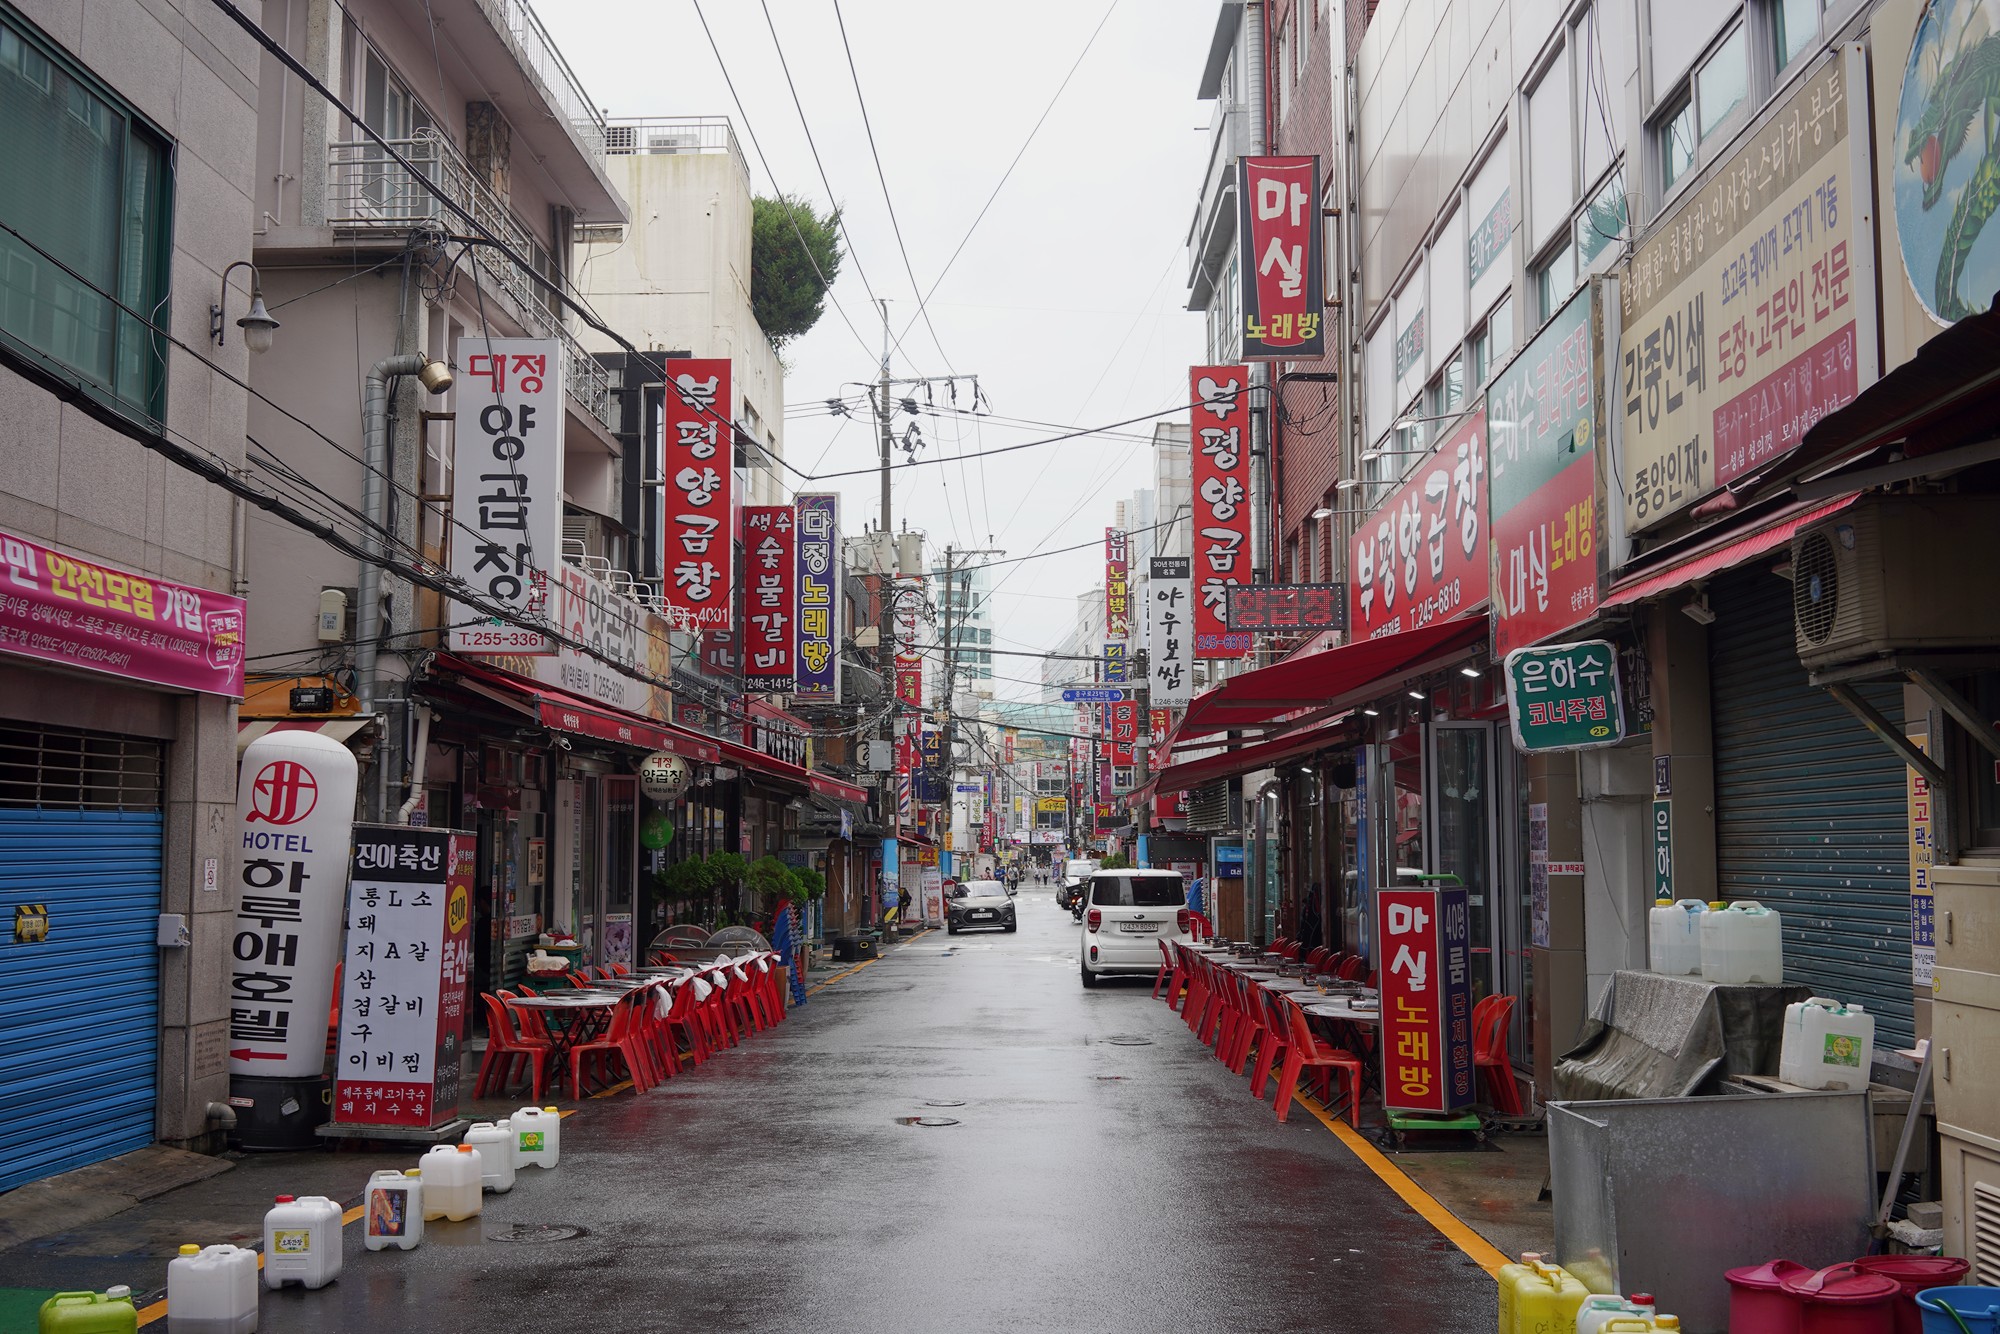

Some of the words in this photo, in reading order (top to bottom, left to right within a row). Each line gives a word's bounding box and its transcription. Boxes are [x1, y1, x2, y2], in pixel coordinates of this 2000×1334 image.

[1815, 174, 1838, 233] 가동
[1257, 177, 1308, 298] 마실
[1811, 239, 1850, 324] 전문
[1246, 312, 1320, 340] 노래방
[469, 353, 546, 394] 대정
[1625, 291, 1707, 434] 각종인쇄
[1492, 369, 1534, 479] 은하수
[1536, 318, 1589, 439] 코너주점
[473, 403, 536, 601] 양곱창
[673, 373, 721, 600] 부평양곱창
[1198, 376, 1245, 622] 부평양곱창
[750, 512, 791, 533] 생수
[803, 510, 834, 574] 다정
[1357, 432, 1483, 622] 부평양곱창
[1509, 523, 1549, 616] 마실
[1551, 494, 1593, 572] 노래방
[0, 536, 39, 591] 민
[157, 584, 203, 633] 가입
[752, 537, 788, 668] 숯불갈비
[1108, 565, 1126, 613] 노래방
[1234, 588, 1335, 626] 양곱창
[75, 615, 103, 638] 스쿨존
[105, 621, 139, 645] 교통사고
[140, 630, 151, 646] 등
[668, 607, 728, 623] 55-4001
[803, 576, 830, 673] 노래방
[460, 631, 546, 648] T.255-3361
[1198, 634, 1251, 651] 245-6818
[747, 679, 793, 690] 246-1415
[1522, 653, 1605, 694] 은하수
[1528, 695, 1608, 727] 코너주점
[1592, 727, 1607, 737] 2F
[642, 769, 684, 784] 양곱창
[651, 757, 673, 770] 대정
[1658, 767, 1667, 784] 21
[242, 831, 313, 854] HOTEL
[356, 843, 441, 871] 진아축산
[450, 895, 466, 926] 진아
[230, 858, 310, 1044] 하루애호텔
[442, 937, 468, 985] 축산
[1387, 902, 1430, 992] 마실
[1396, 996, 1433, 1097] 노래방
